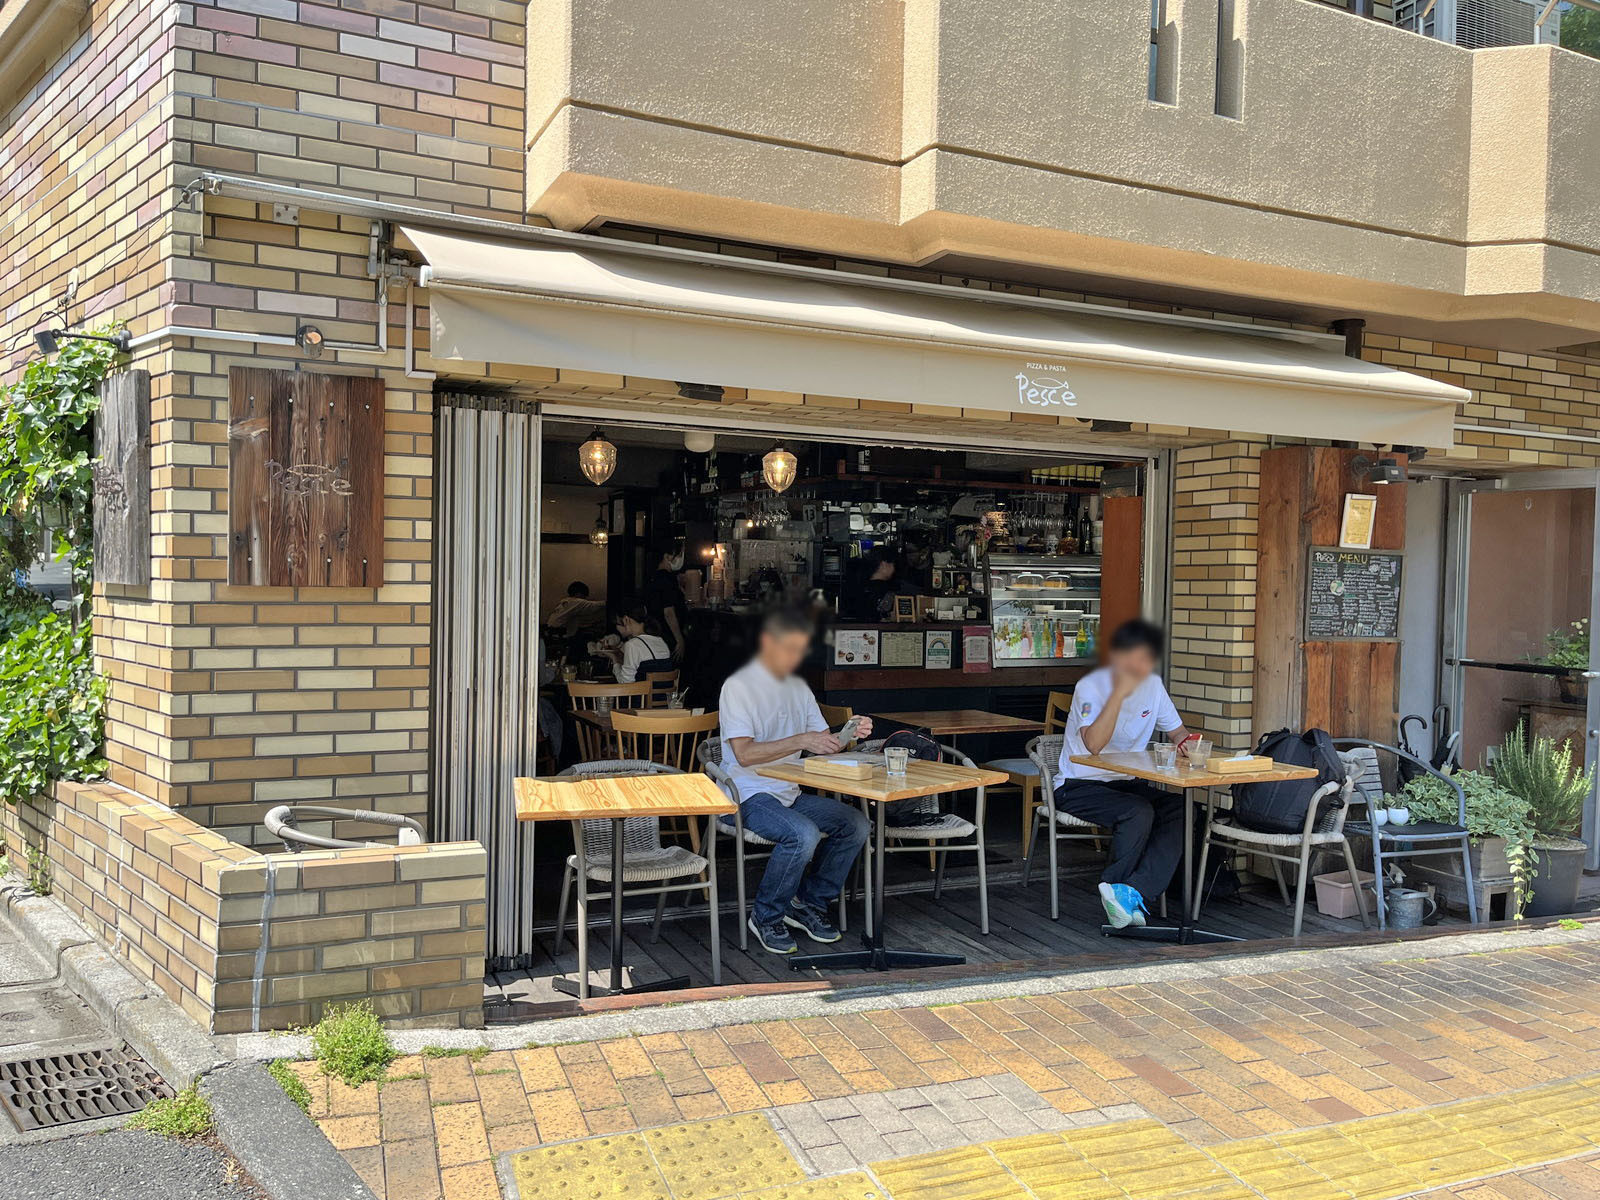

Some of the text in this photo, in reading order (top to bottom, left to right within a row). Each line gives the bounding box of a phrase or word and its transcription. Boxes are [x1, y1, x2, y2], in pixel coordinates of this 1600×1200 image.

[1026, 362, 1043, 370] PIZZA
[1049, 364, 1066, 372] PASTA
[1015, 372, 1078, 406] Pesce
[804, 509, 815, 521] 13
[1338, 553, 1368, 564] MENU
